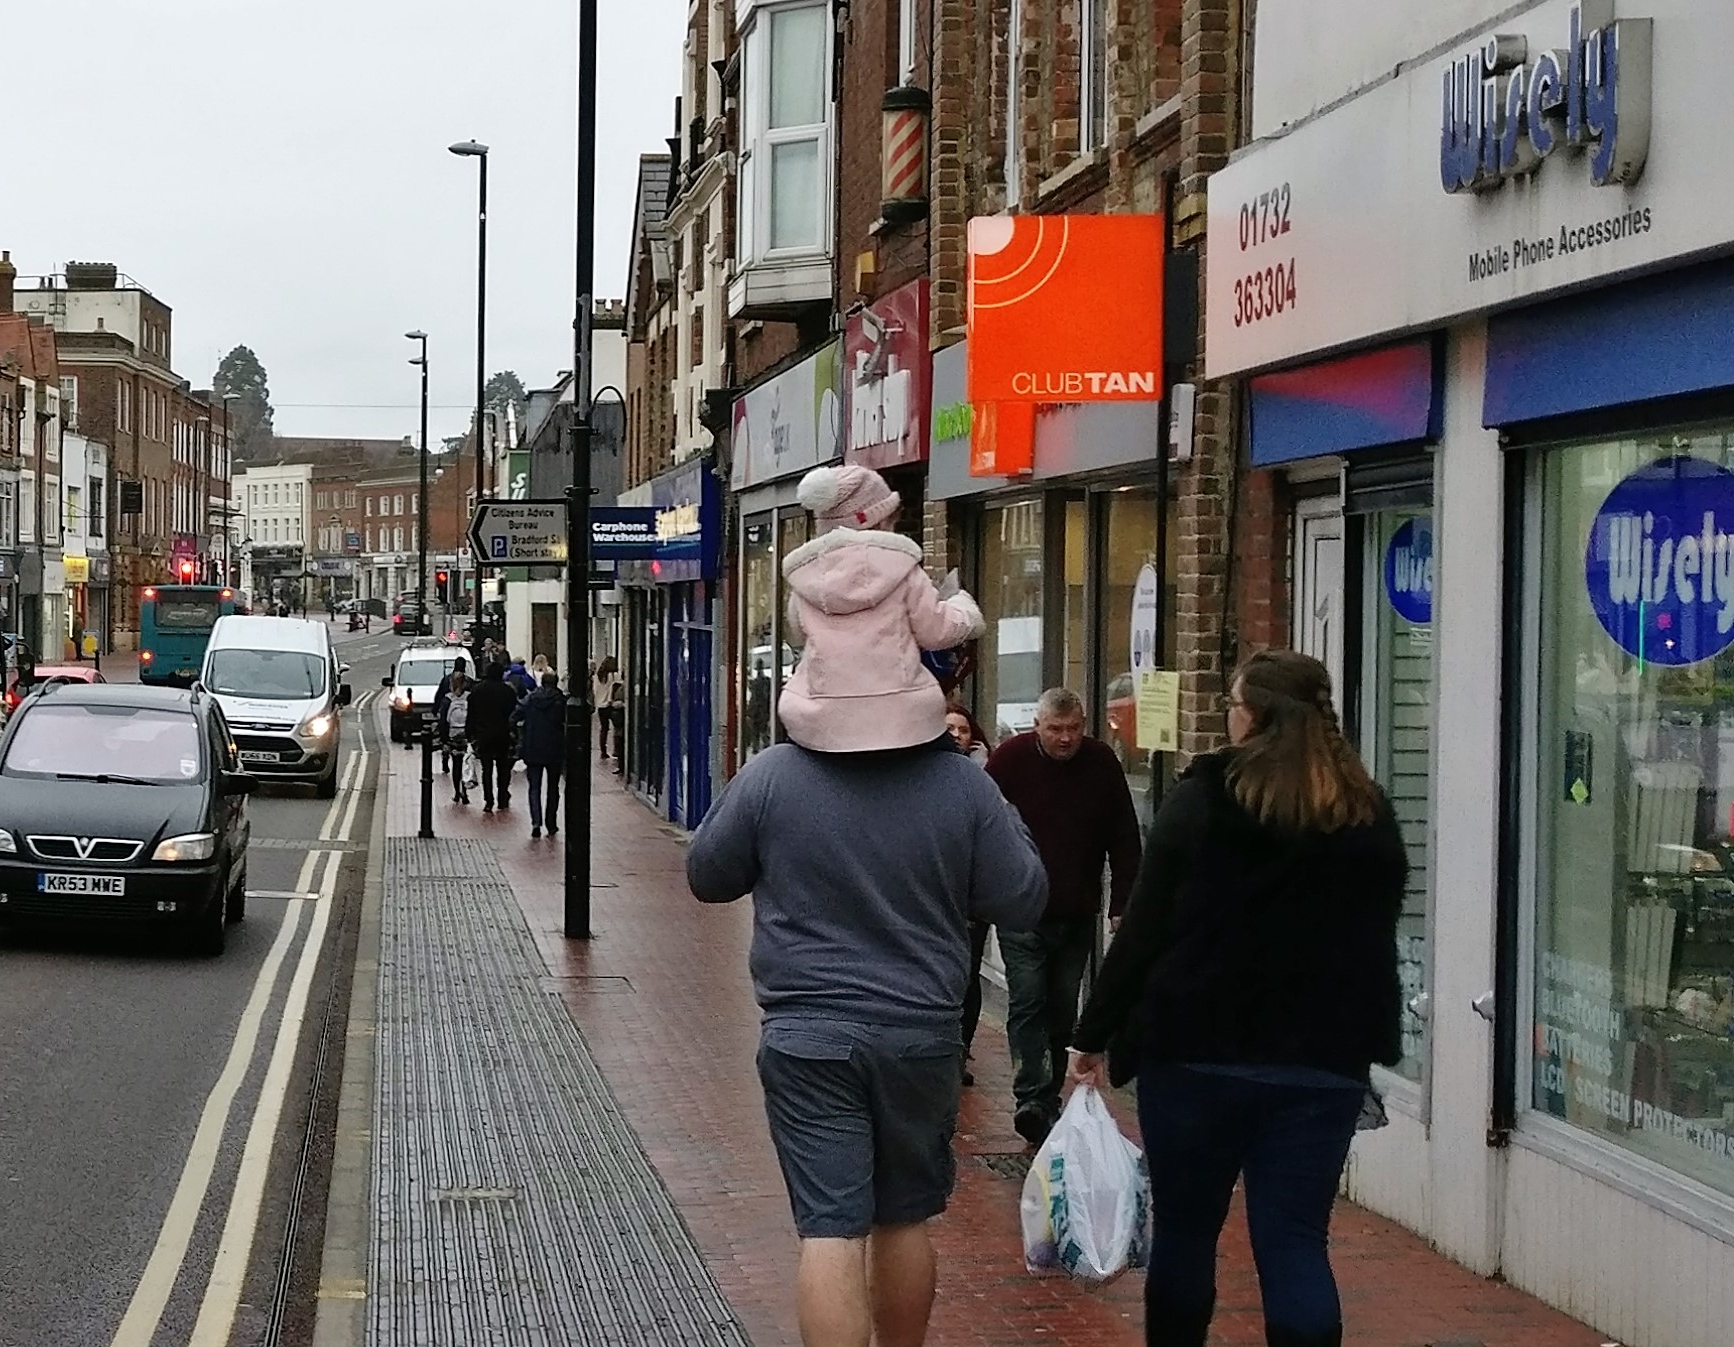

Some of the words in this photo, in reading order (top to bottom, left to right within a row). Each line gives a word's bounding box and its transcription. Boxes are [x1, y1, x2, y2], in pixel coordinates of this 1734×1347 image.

[1440, 6, 1619, 194] Wisely
[1239, 181, 1293, 251] 01732
[1468, 247, 1509, 283] Mobile
[1512, 233, 1554, 270] Phone
[1558, 205, 1652, 255] Accessories
[1234, 257, 1298, 328] 363304
[491, 508, 524, 518] Citizens
[527, 508, 554, 518] Advice
[508, 519, 539, 530] Bureau
[592, 522, 648, 534] Carphone
[511, 534, 548, 545] Bradford
[592, 532, 655, 542] Warehouse
[1608, 510, 1734, 635] Wisely
[47, 875, 87, 892] KR53
[92, 877, 122, 893] MWE
[1540, 1060, 1565, 1095] LCD
[1574, 1075, 1630, 1124] SCREEN
[1633, 1098, 1734, 1160] PROTECTORS
